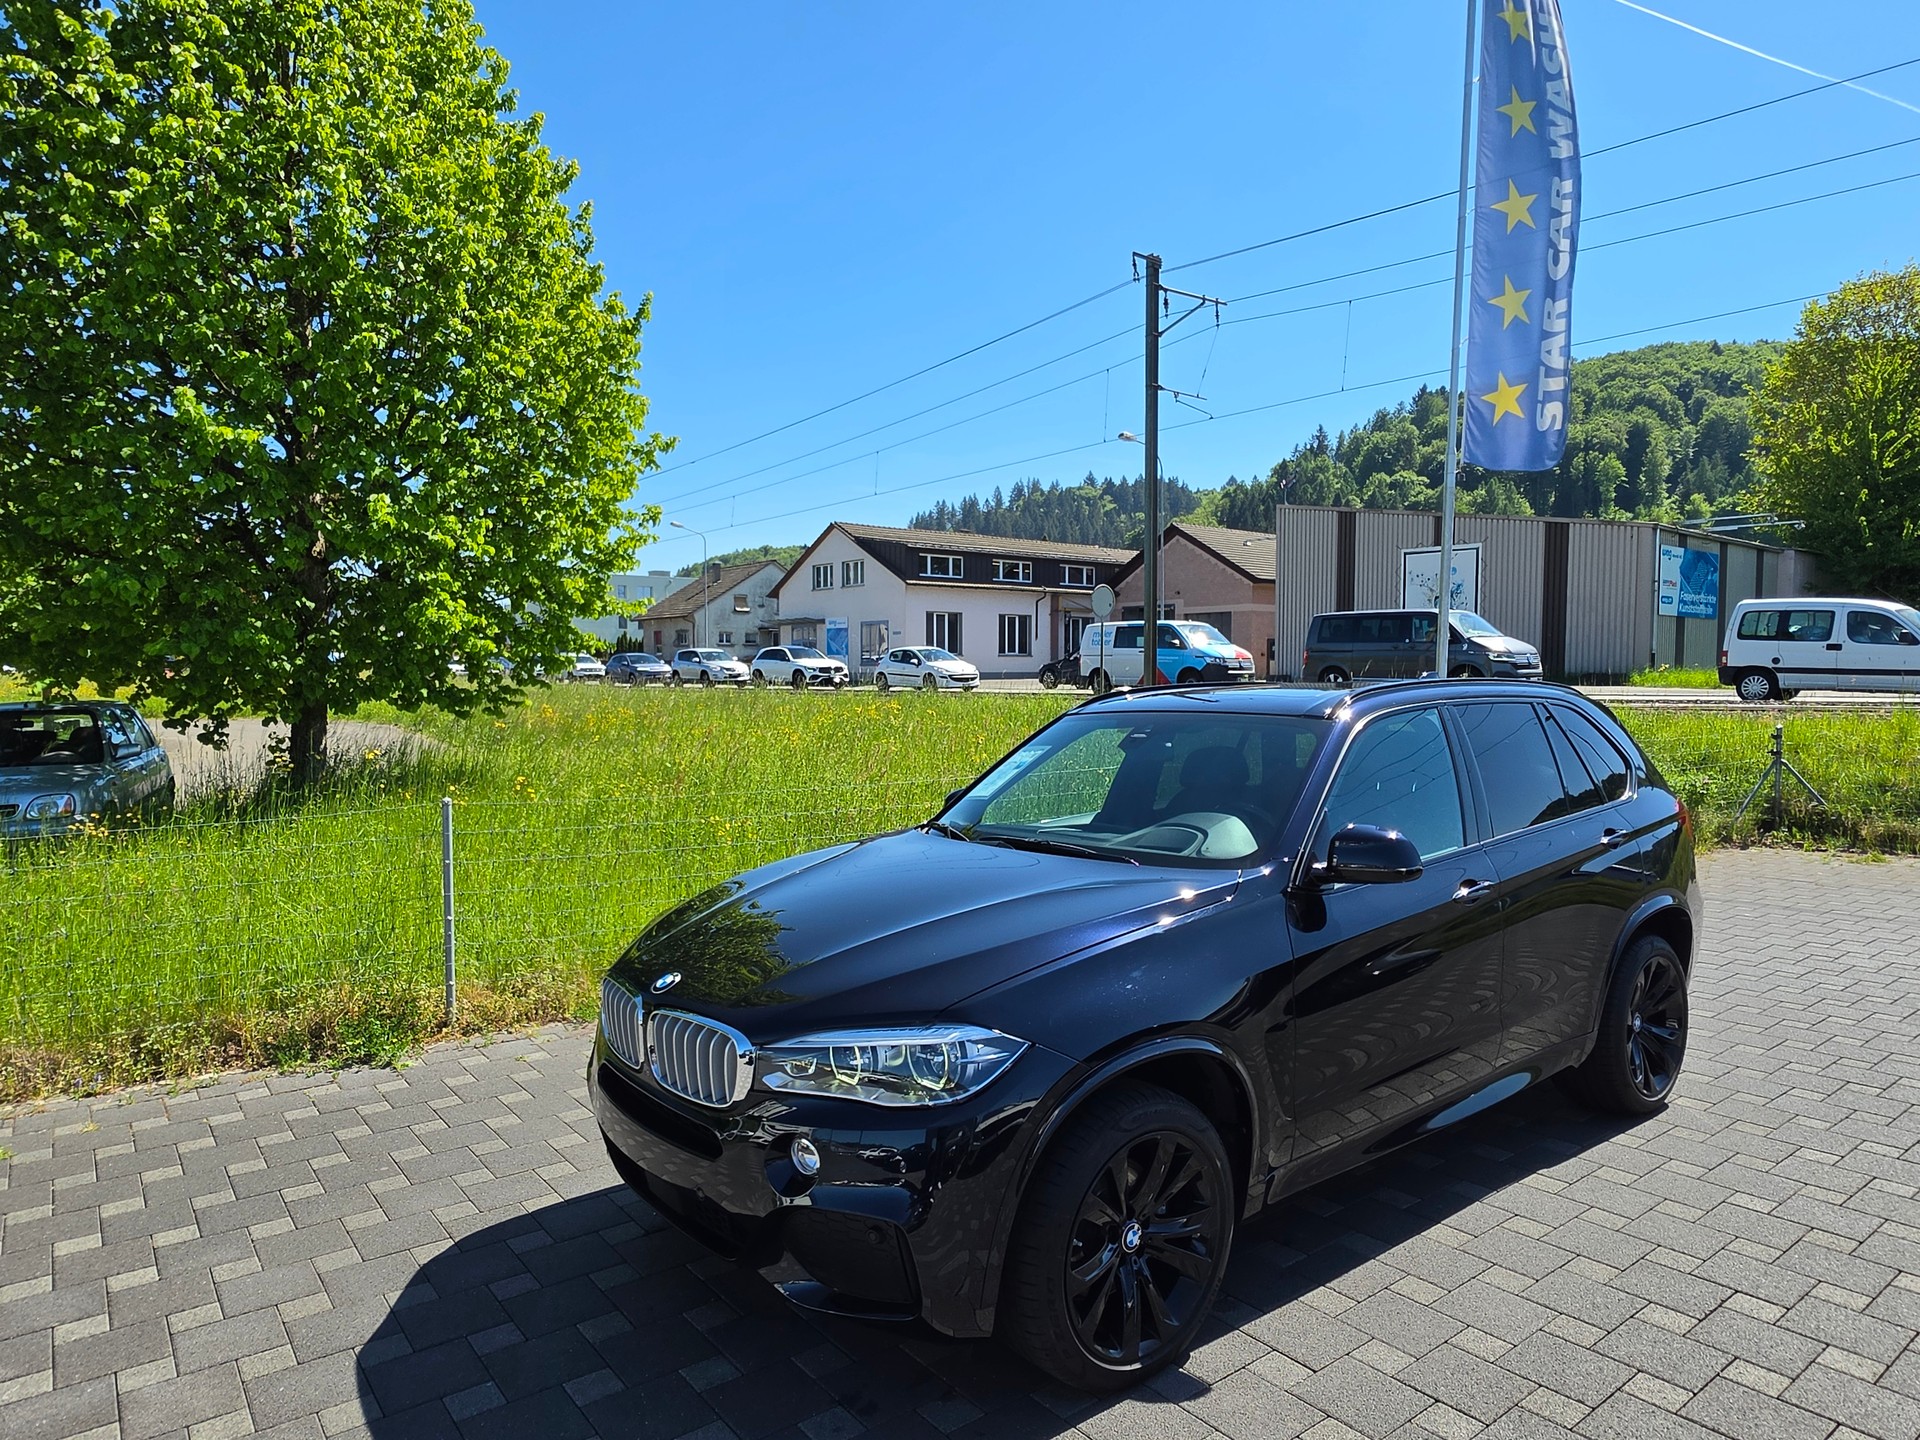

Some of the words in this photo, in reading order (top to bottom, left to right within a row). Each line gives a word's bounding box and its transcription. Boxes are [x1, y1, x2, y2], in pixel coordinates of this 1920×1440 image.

[1539, 12, 1574, 159] WASH
[1547, 175, 1573, 281] CAR
[1536, 297, 1569, 432] STAR
